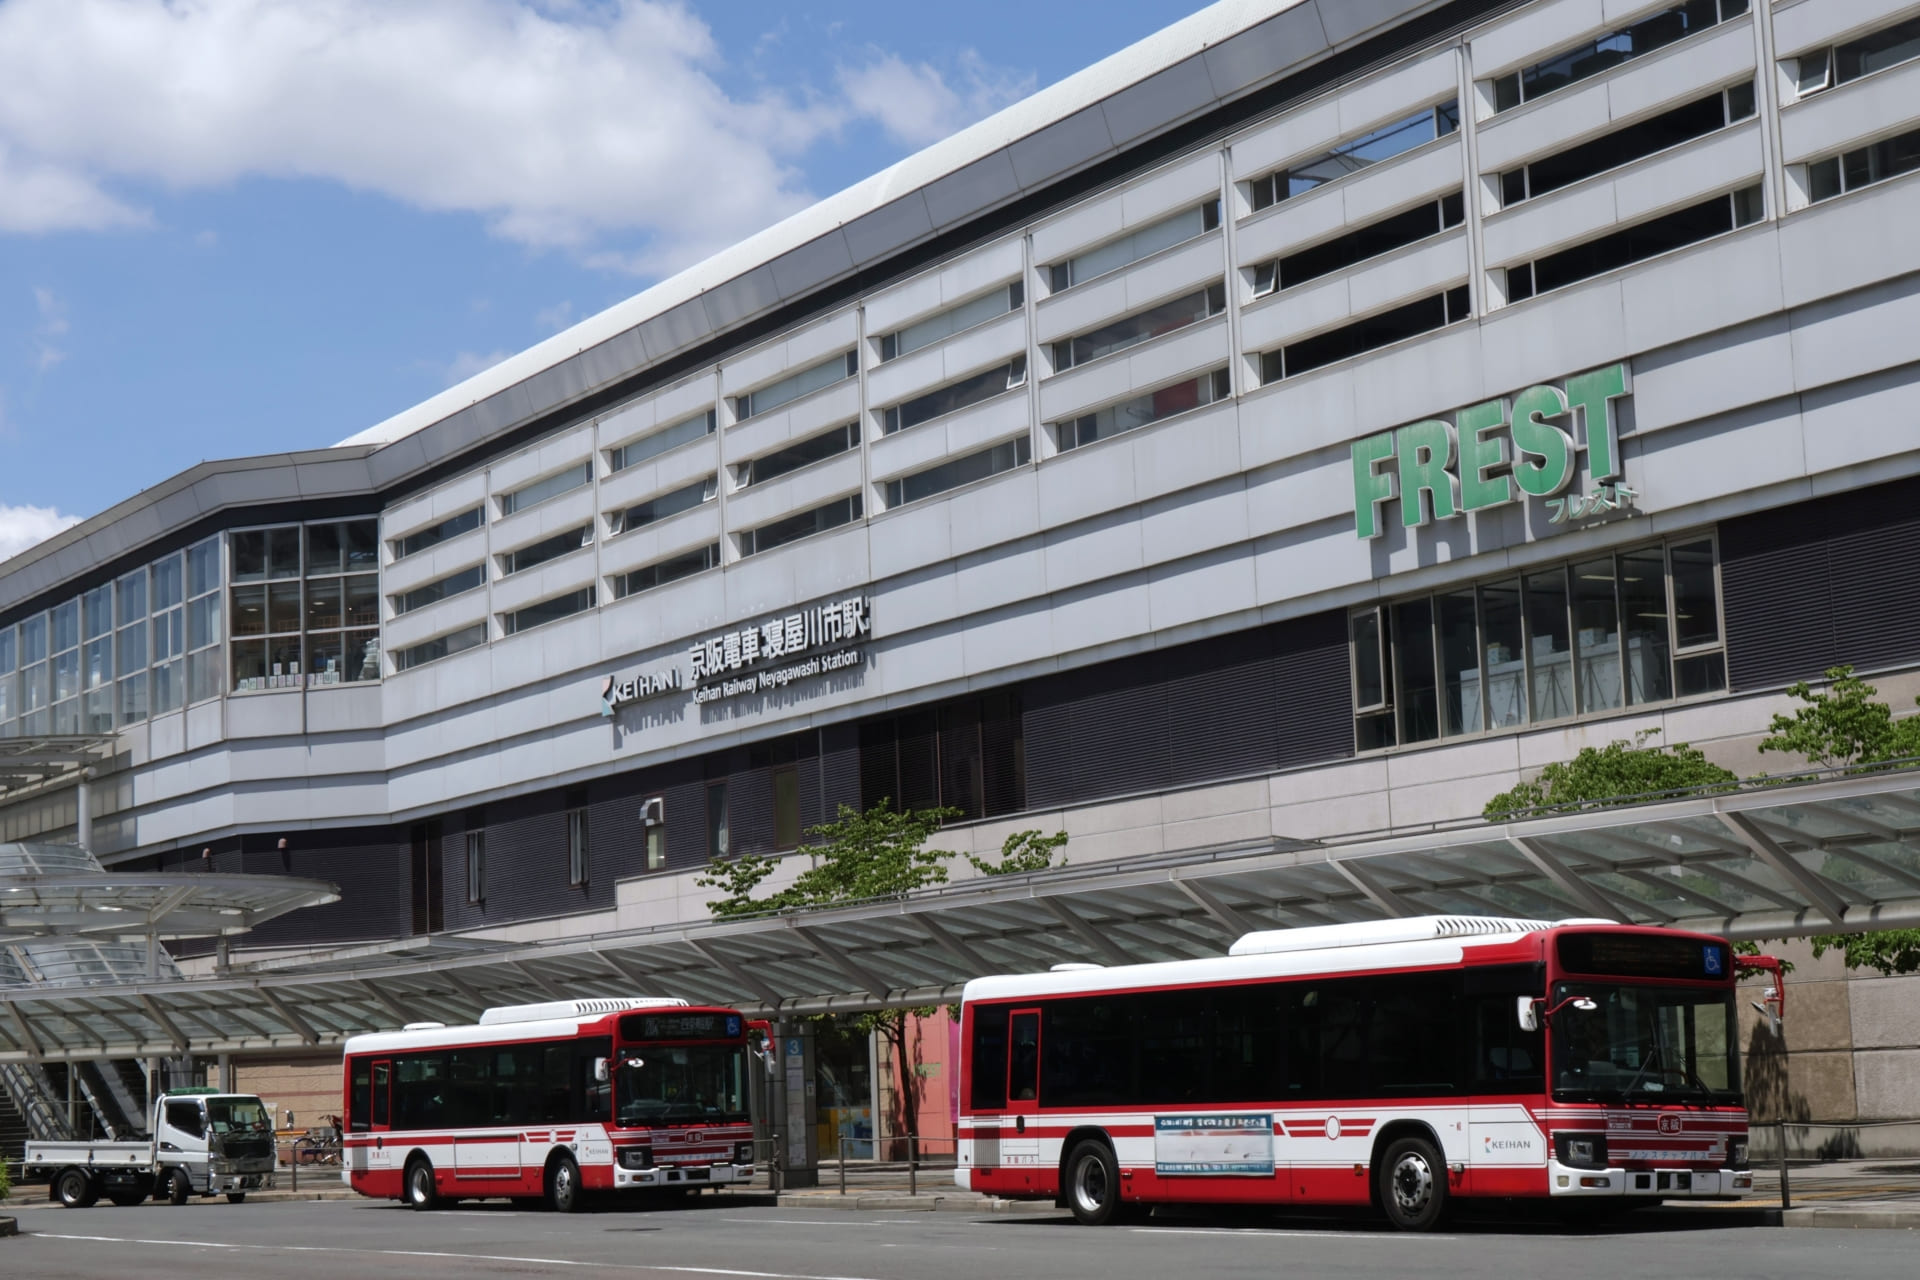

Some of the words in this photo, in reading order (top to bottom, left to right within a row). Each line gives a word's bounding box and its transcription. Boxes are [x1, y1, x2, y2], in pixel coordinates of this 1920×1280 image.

[1351, 362, 1631, 540] FREST
[1545, 482, 1635, 524] フレスト
[609, 667, 680, 704] KEIHAN
[692, 685, 721, 705] Keihan
[723, 678, 757, 698] Railway
[759, 657, 819, 689] Neyagawashi
[821, 651, 858, 670] Station
[790, 1040, 800, 1054] 3
[1661, 1118, 1679, 1131] 京阪
[1492, 1141, 1530, 1149] KEIHAN
[1631, 1151, 1707, 1160] ノンステップバス
